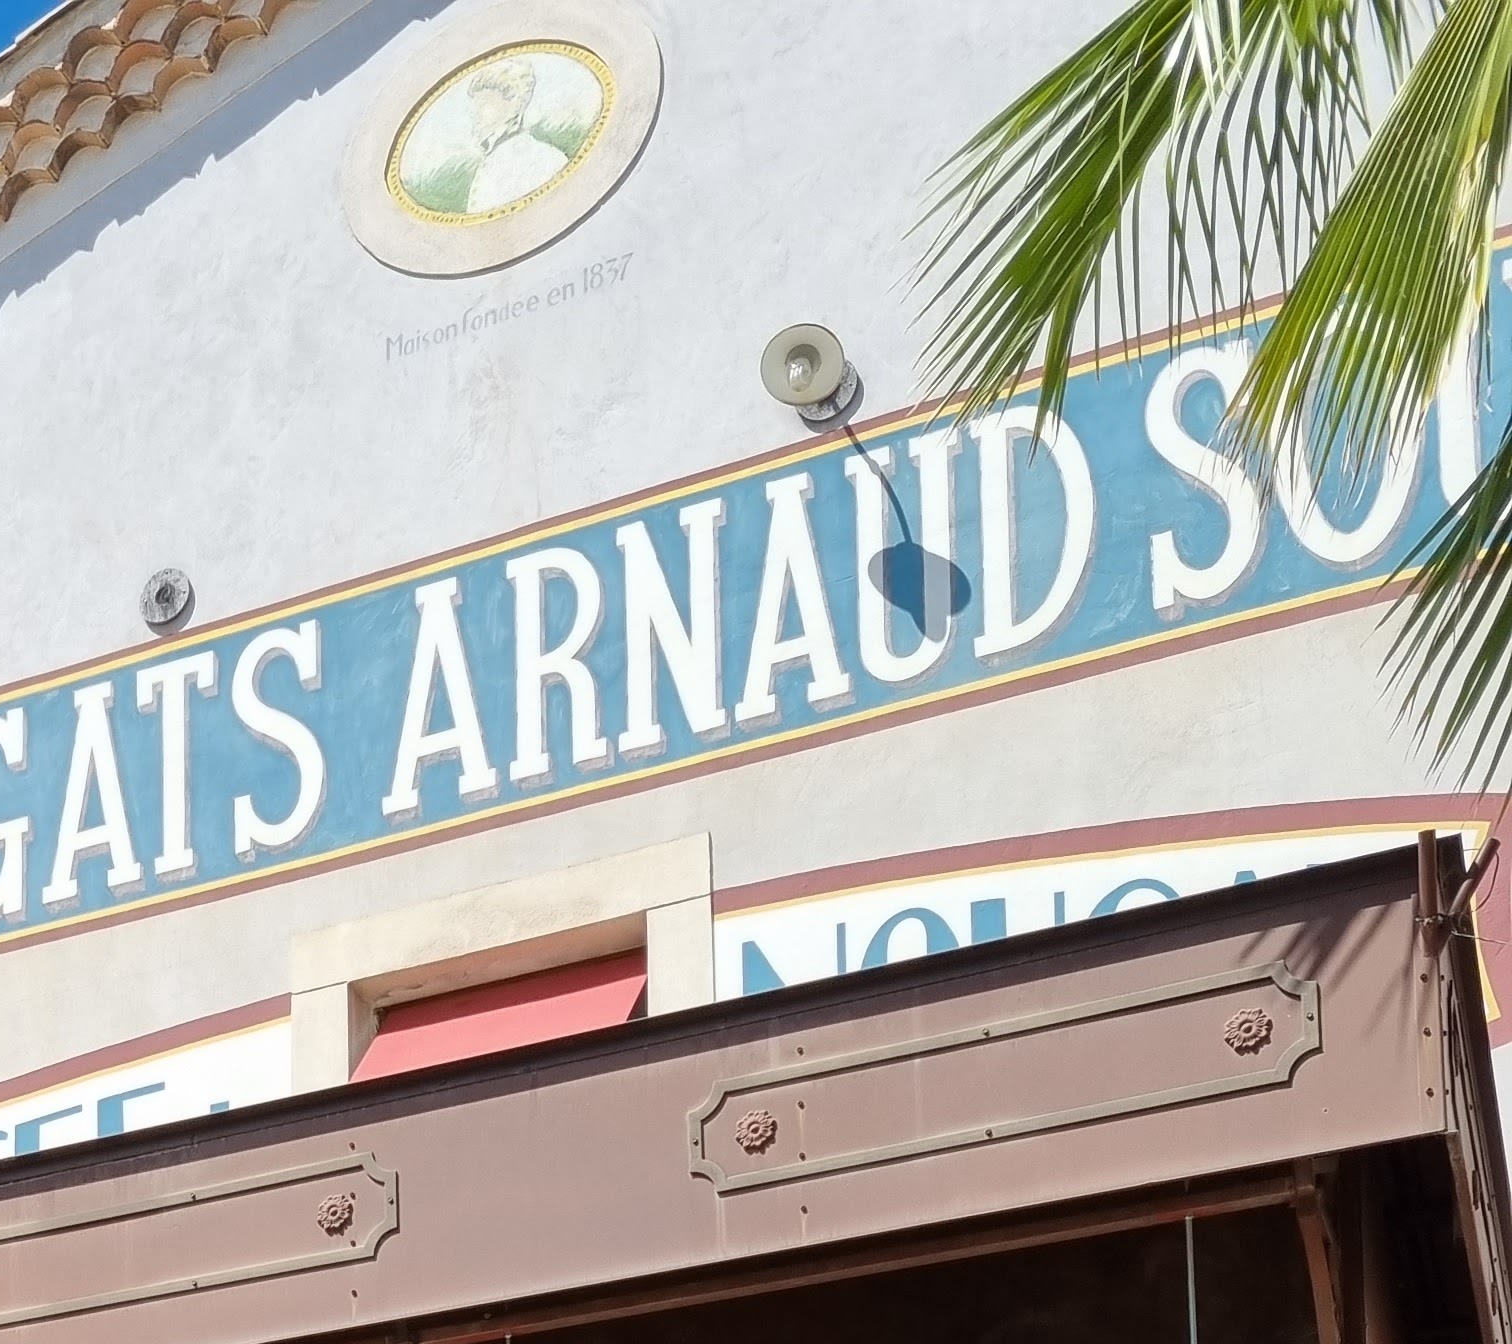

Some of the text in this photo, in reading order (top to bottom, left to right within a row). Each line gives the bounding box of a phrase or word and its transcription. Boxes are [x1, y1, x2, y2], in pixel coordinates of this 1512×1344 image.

[385, 322, 457, 363] Maison
[546, 282, 575, 306] en
[582, 252, 634, 293] 1837
[380, 404, 1092, 820] ARNAUD
